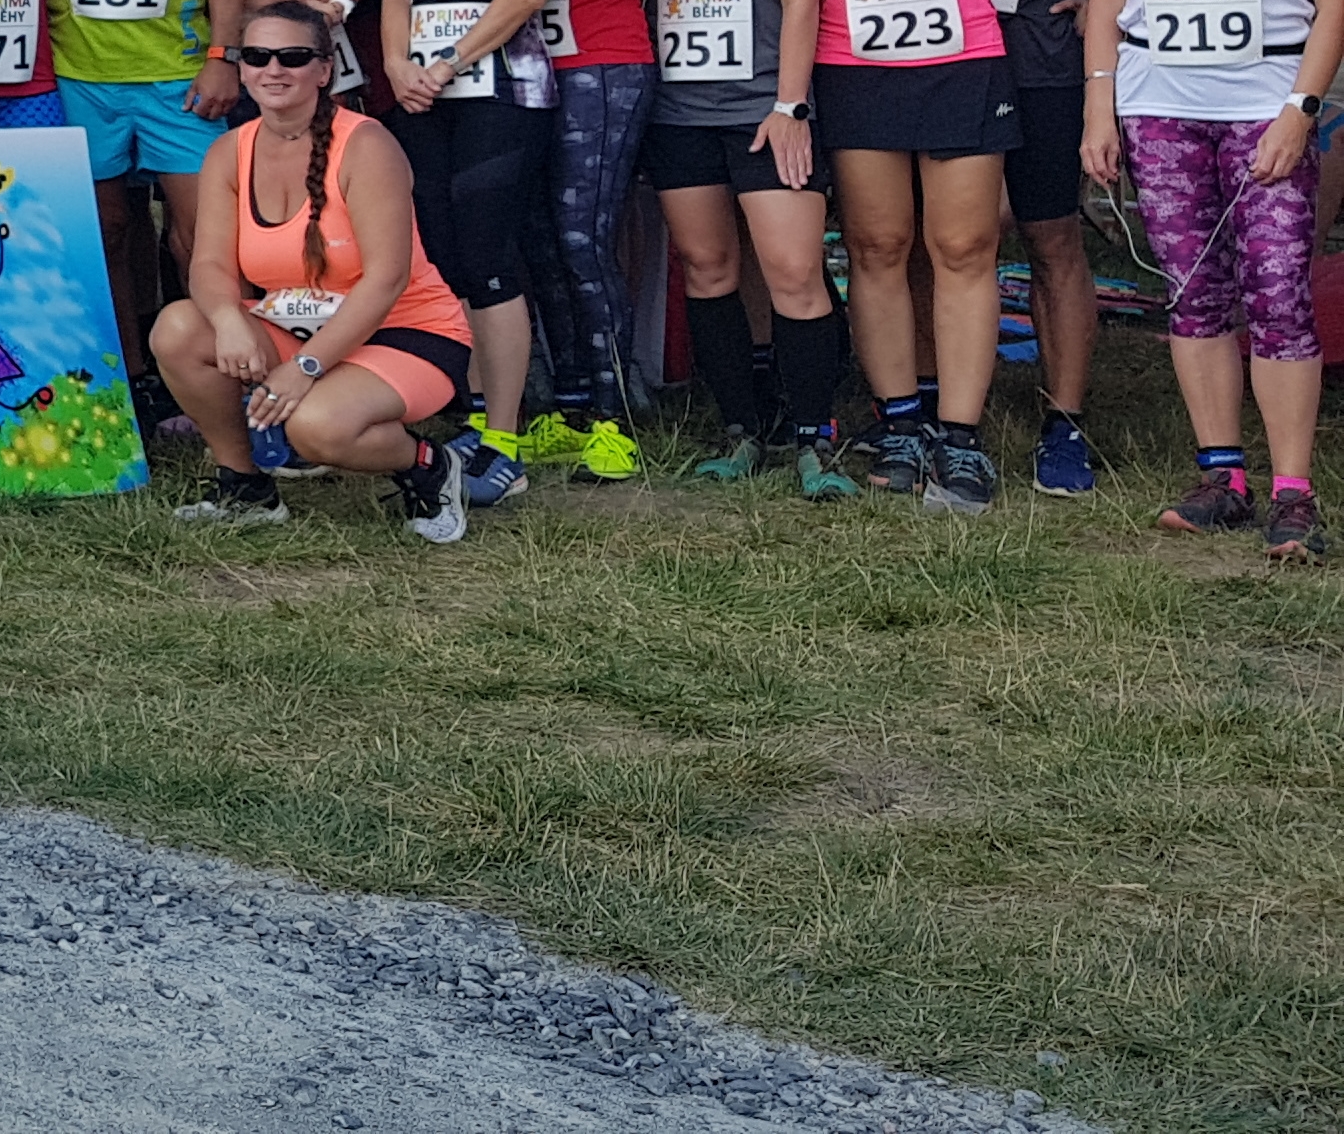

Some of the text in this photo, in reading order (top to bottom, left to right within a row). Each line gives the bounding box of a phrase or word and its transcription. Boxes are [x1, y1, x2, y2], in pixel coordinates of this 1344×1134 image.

[426, 8, 482, 24] PRIMA
[692, 3, 733, 19] BĚHY
[859, 7, 953, 52] 223
[1155, 10, 1252, 53] 219
[663, 29, 743, 69] 251
[286, 299, 324, 316] BĚHY
